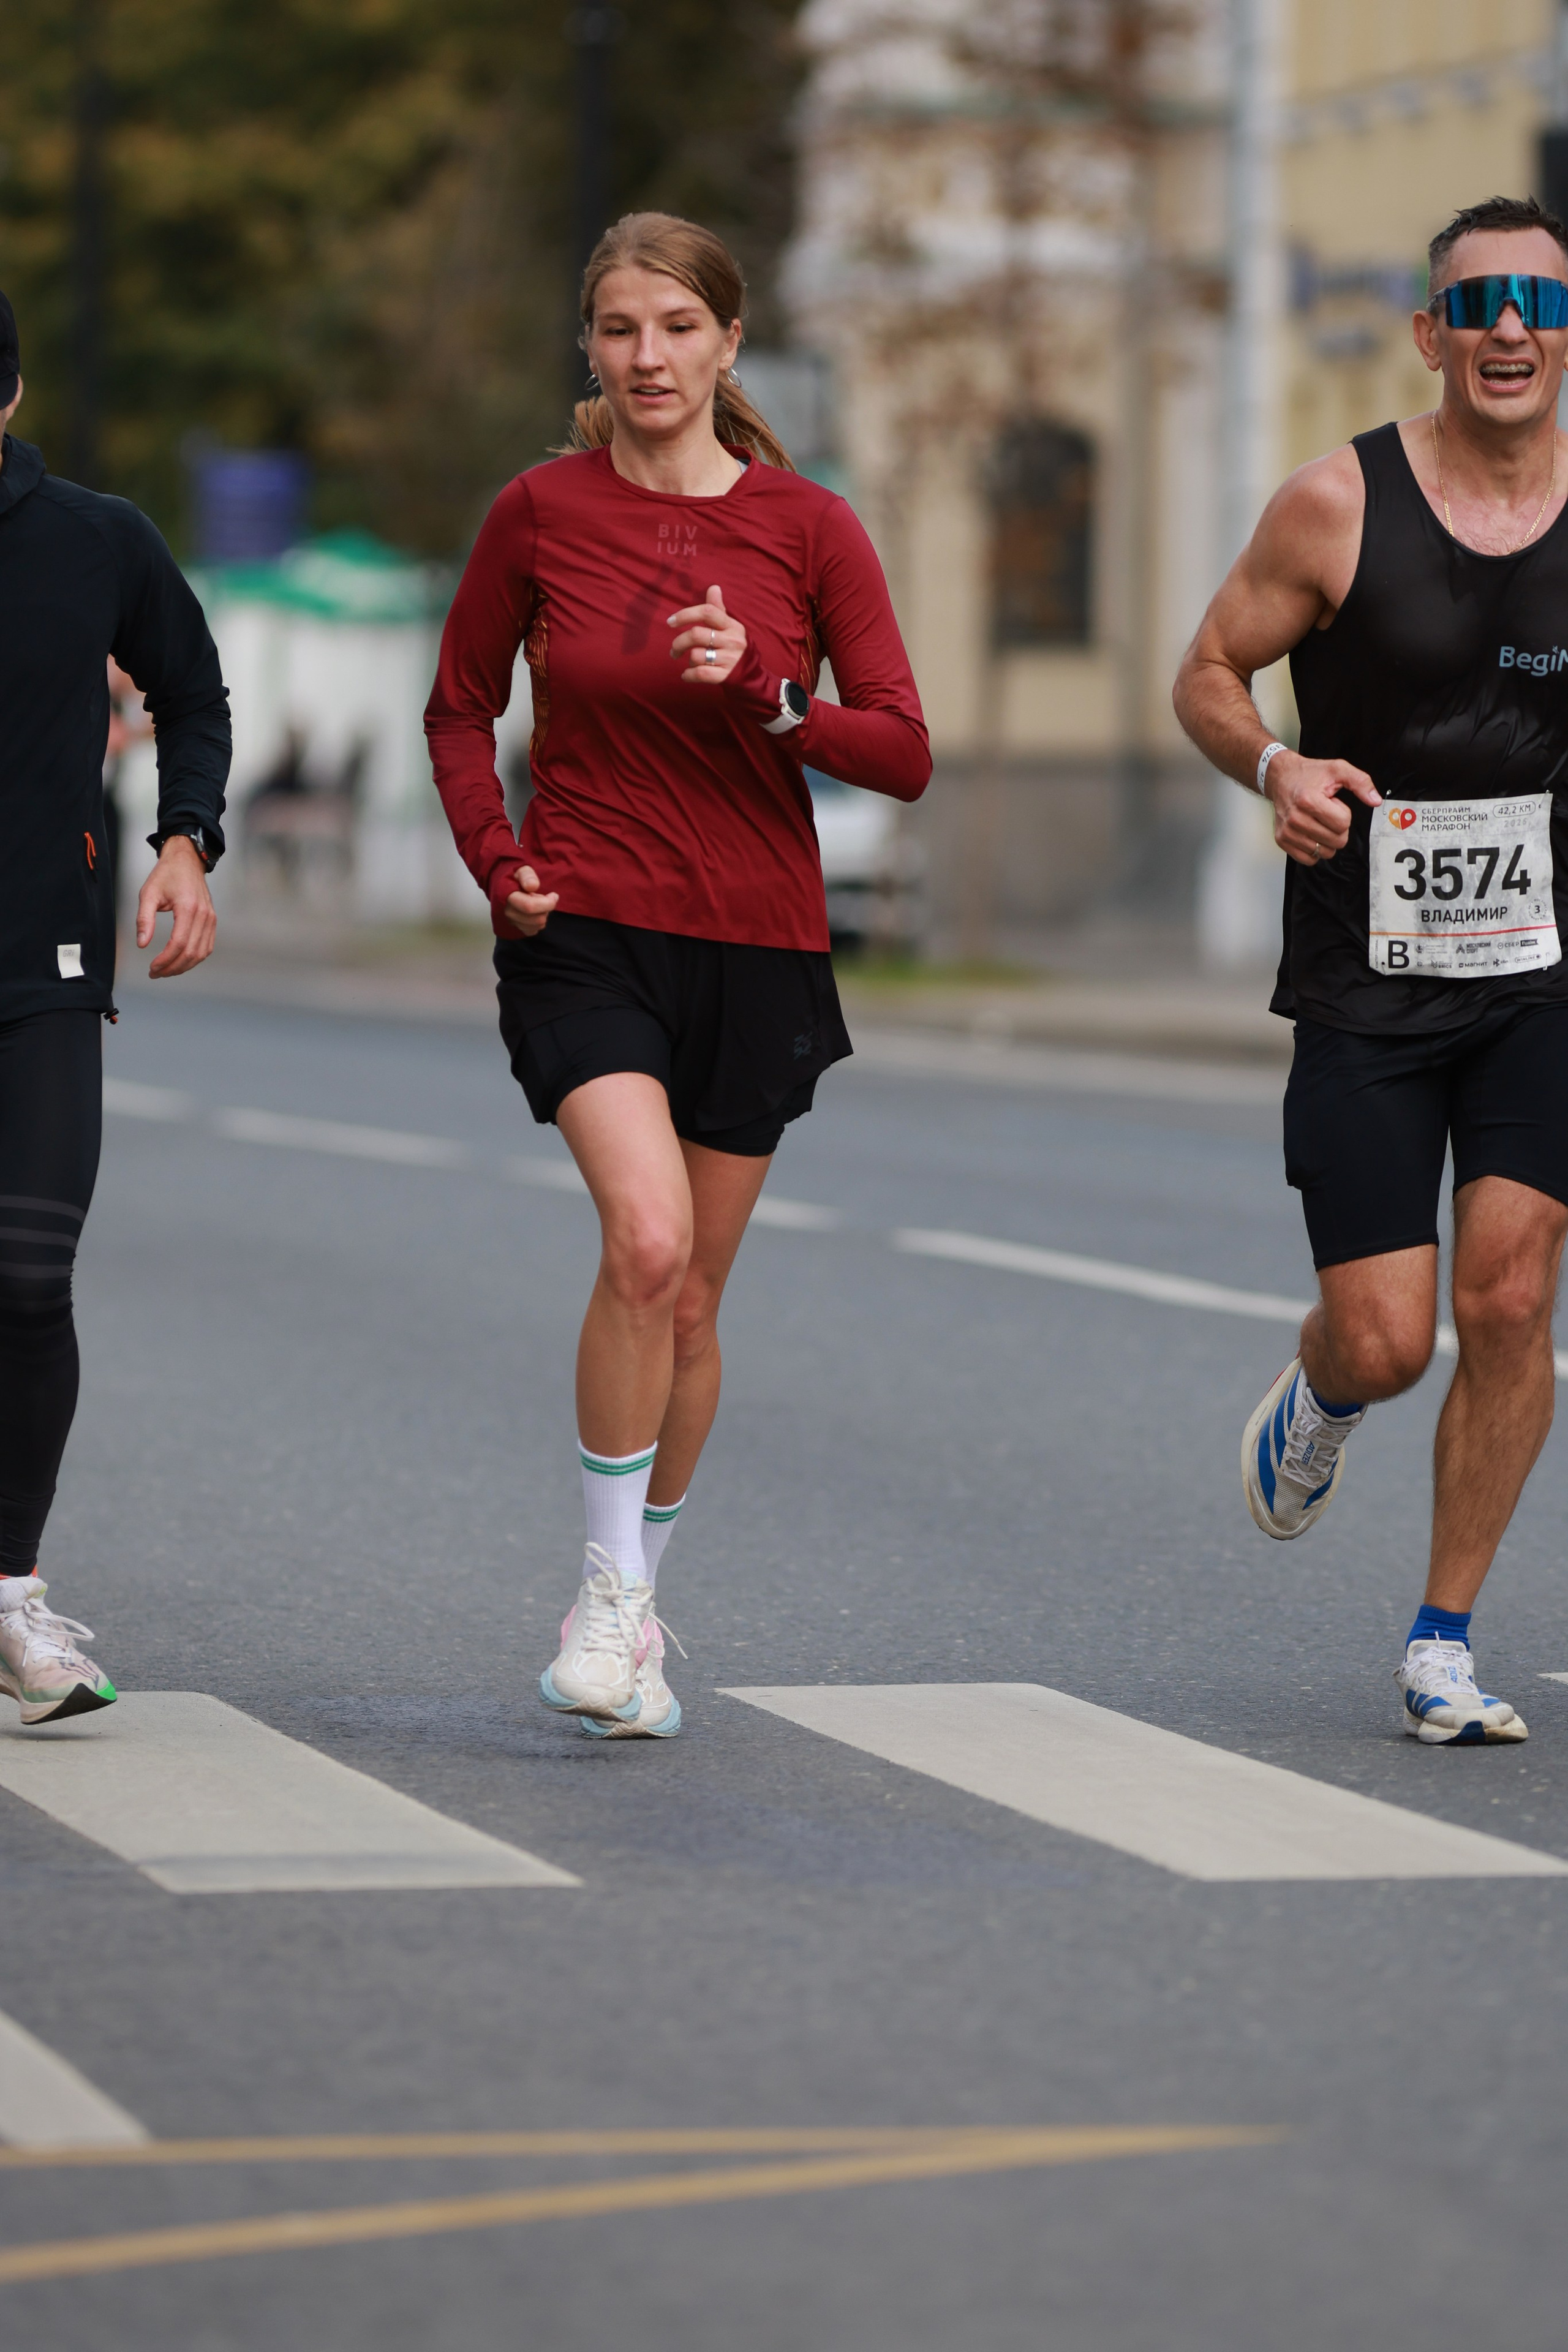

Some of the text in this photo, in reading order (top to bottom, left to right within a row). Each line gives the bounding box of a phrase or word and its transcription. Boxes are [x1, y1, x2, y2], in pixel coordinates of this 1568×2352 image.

[658, 524, 698, 540] BIV
[657, 541, 696, 556] IUM
[1498, 805, 1517, 815] 42,2
[1422, 813, 1488, 823] МОСКОВСКИЙ
[1422, 823, 1471, 831] МАРАФОН
[1394, 844, 1531, 900] 3574
[1534, 905, 1540, 913] 3
[1421, 907, 1508, 924] ВЛАДИМИР
